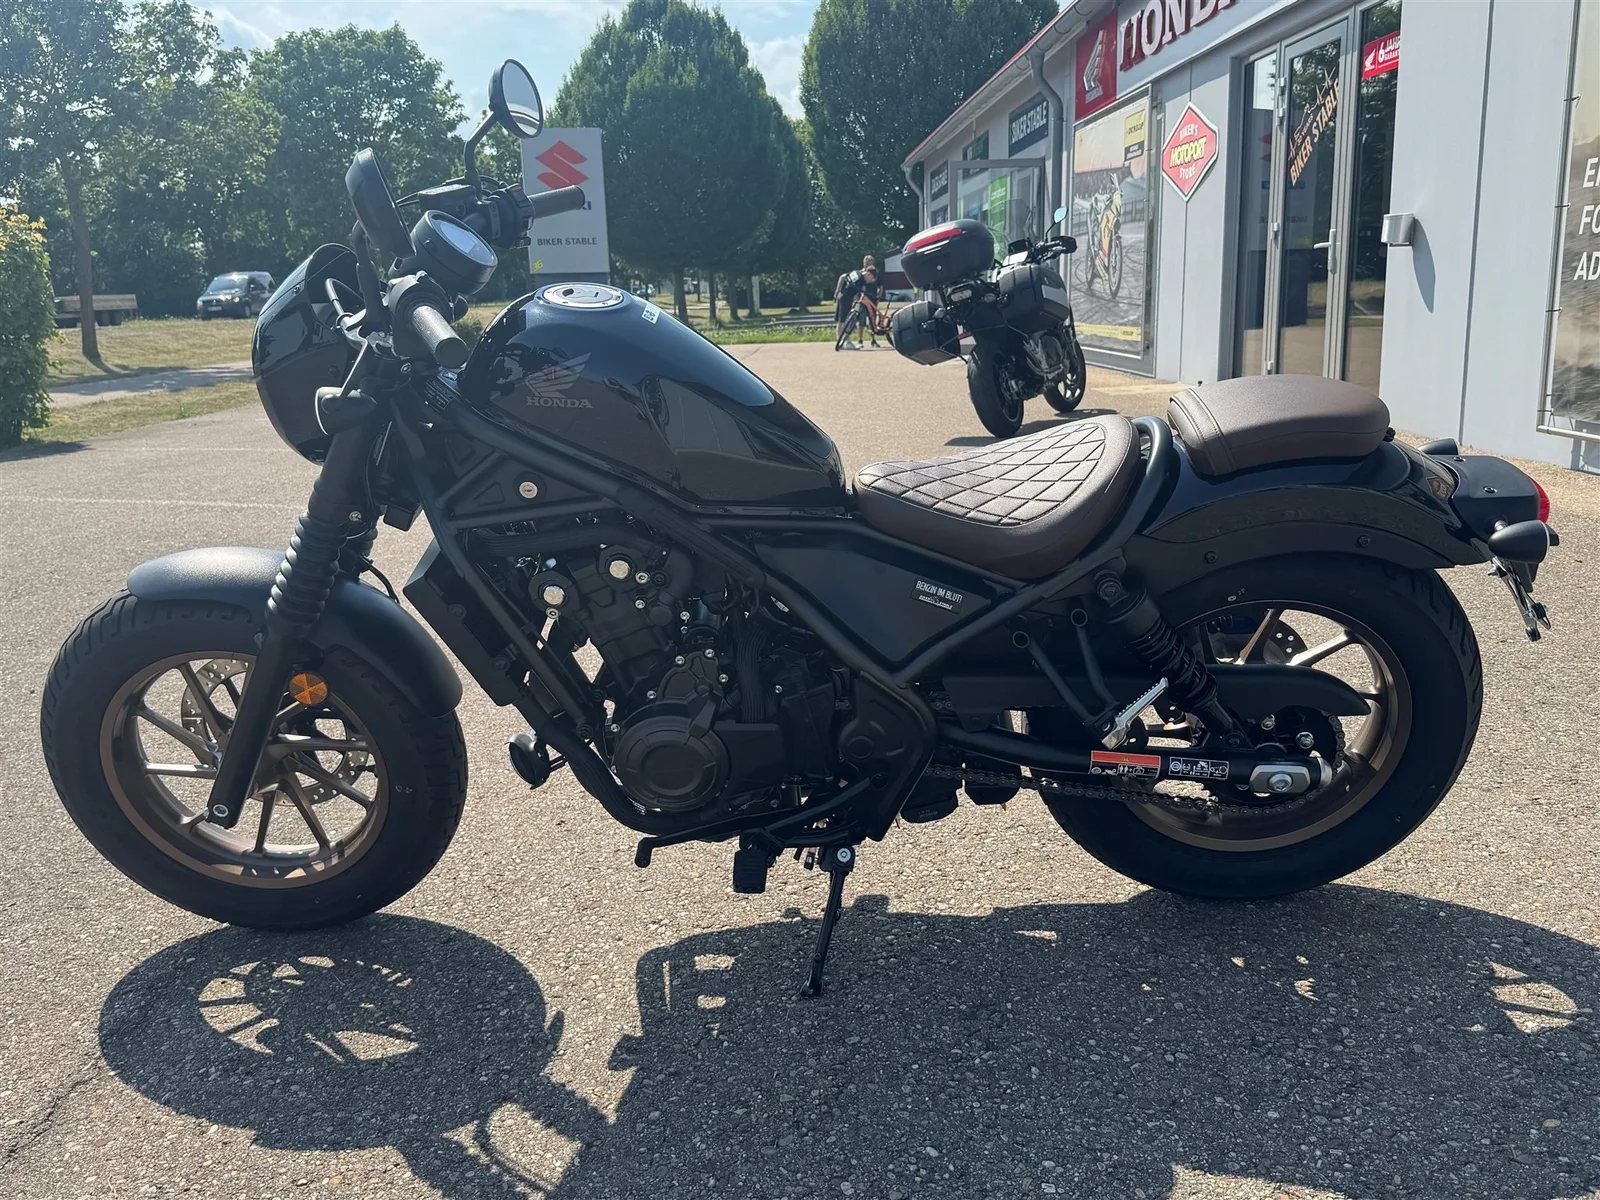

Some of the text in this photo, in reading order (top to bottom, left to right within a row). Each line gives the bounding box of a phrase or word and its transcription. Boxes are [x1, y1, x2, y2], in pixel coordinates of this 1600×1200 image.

[1120, 0, 1233, 71] HON
[1378, 41, 1385, 63] 6
[1028, 100, 1047, 134] STABLE
[1169, 135, 1207, 168] MOTOPORT
[1290, 136, 1313, 186] BIKER
[537, 237, 598, 246] BIKER STABLE
[1573, 251, 1600, 281] AD
[525, 395, 594, 409] HONDA
[916, 581, 937, 594] BENZIN
[937, 588, 946, 597] IM
